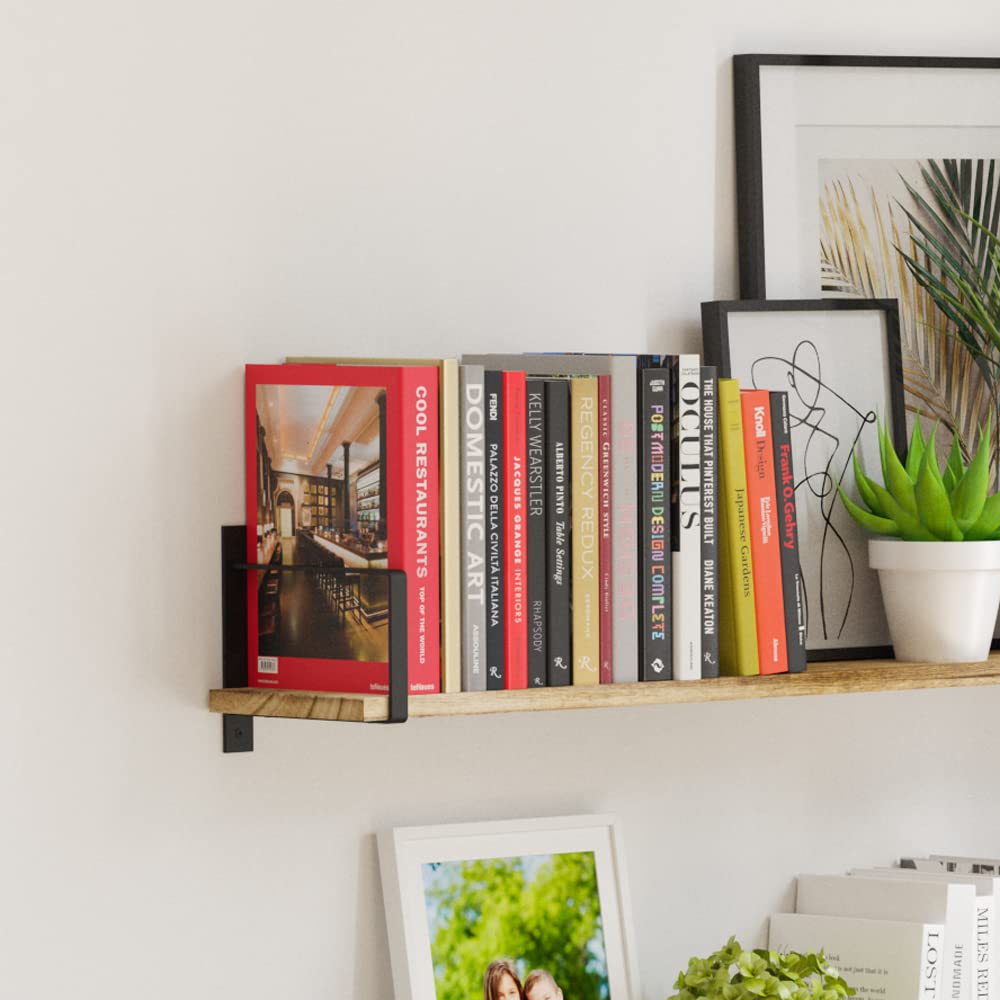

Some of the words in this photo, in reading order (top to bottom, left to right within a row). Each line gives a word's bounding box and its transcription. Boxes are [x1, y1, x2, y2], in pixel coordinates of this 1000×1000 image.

[416, 386, 427, 436] COOL
[489, 393, 497, 420] FENDI
[703, 378, 713, 396] THE
[528, 393, 542, 431] KELLY
[703, 399, 713, 431] HOUSE
[754, 406, 766, 437] Knoll
[466, 383, 483, 540] DOMESTIC
[490, 443, 498, 492] PALAZZO
[555, 441, 564, 482] ALBERTO
[580, 397, 594, 498] REGENCY
[680, 382, 700, 529] OCULUS
[704, 433, 713, 457] THAT
[754, 440, 766, 480] Design
[780, 444, 793, 485] Frank
[529, 435, 542, 516] WEARSTLER
[556, 485, 564, 514] PINTO
[704, 460, 714, 514] PINTEREST
[416, 442, 428, 578] RESTAURANTS
[490, 495, 498, 530] DELLA
[556, 521, 565, 545] Table
[652, 507, 665, 561] DESIGN
[704, 517, 714, 545] BUILT
[735, 488, 748, 542] Japanese
[783, 503, 797, 549] Gehry
[490, 532, 500, 574] CIVILTÀ
[514, 515, 522, 564] GRANGE
[581, 506, 594, 579] REDUX
[467, 551, 484, 604] ART
[553, 548, 565, 585] Settings
[704, 560, 714, 591] DIANE
[740, 545, 752, 598] Gardens
[419, 604, 425, 614] OF
[491, 576, 499, 627] ITALIANA
[514, 569, 522, 623] INTERIORS
[651, 565, 665, 640] COMPLETE
[704, 594, 714, 634] KEATON
[533, 600, 542, 652] RHAPSODY
[977, 907, 989, 963] MILES
[925, 931, 939, 999] LOST
